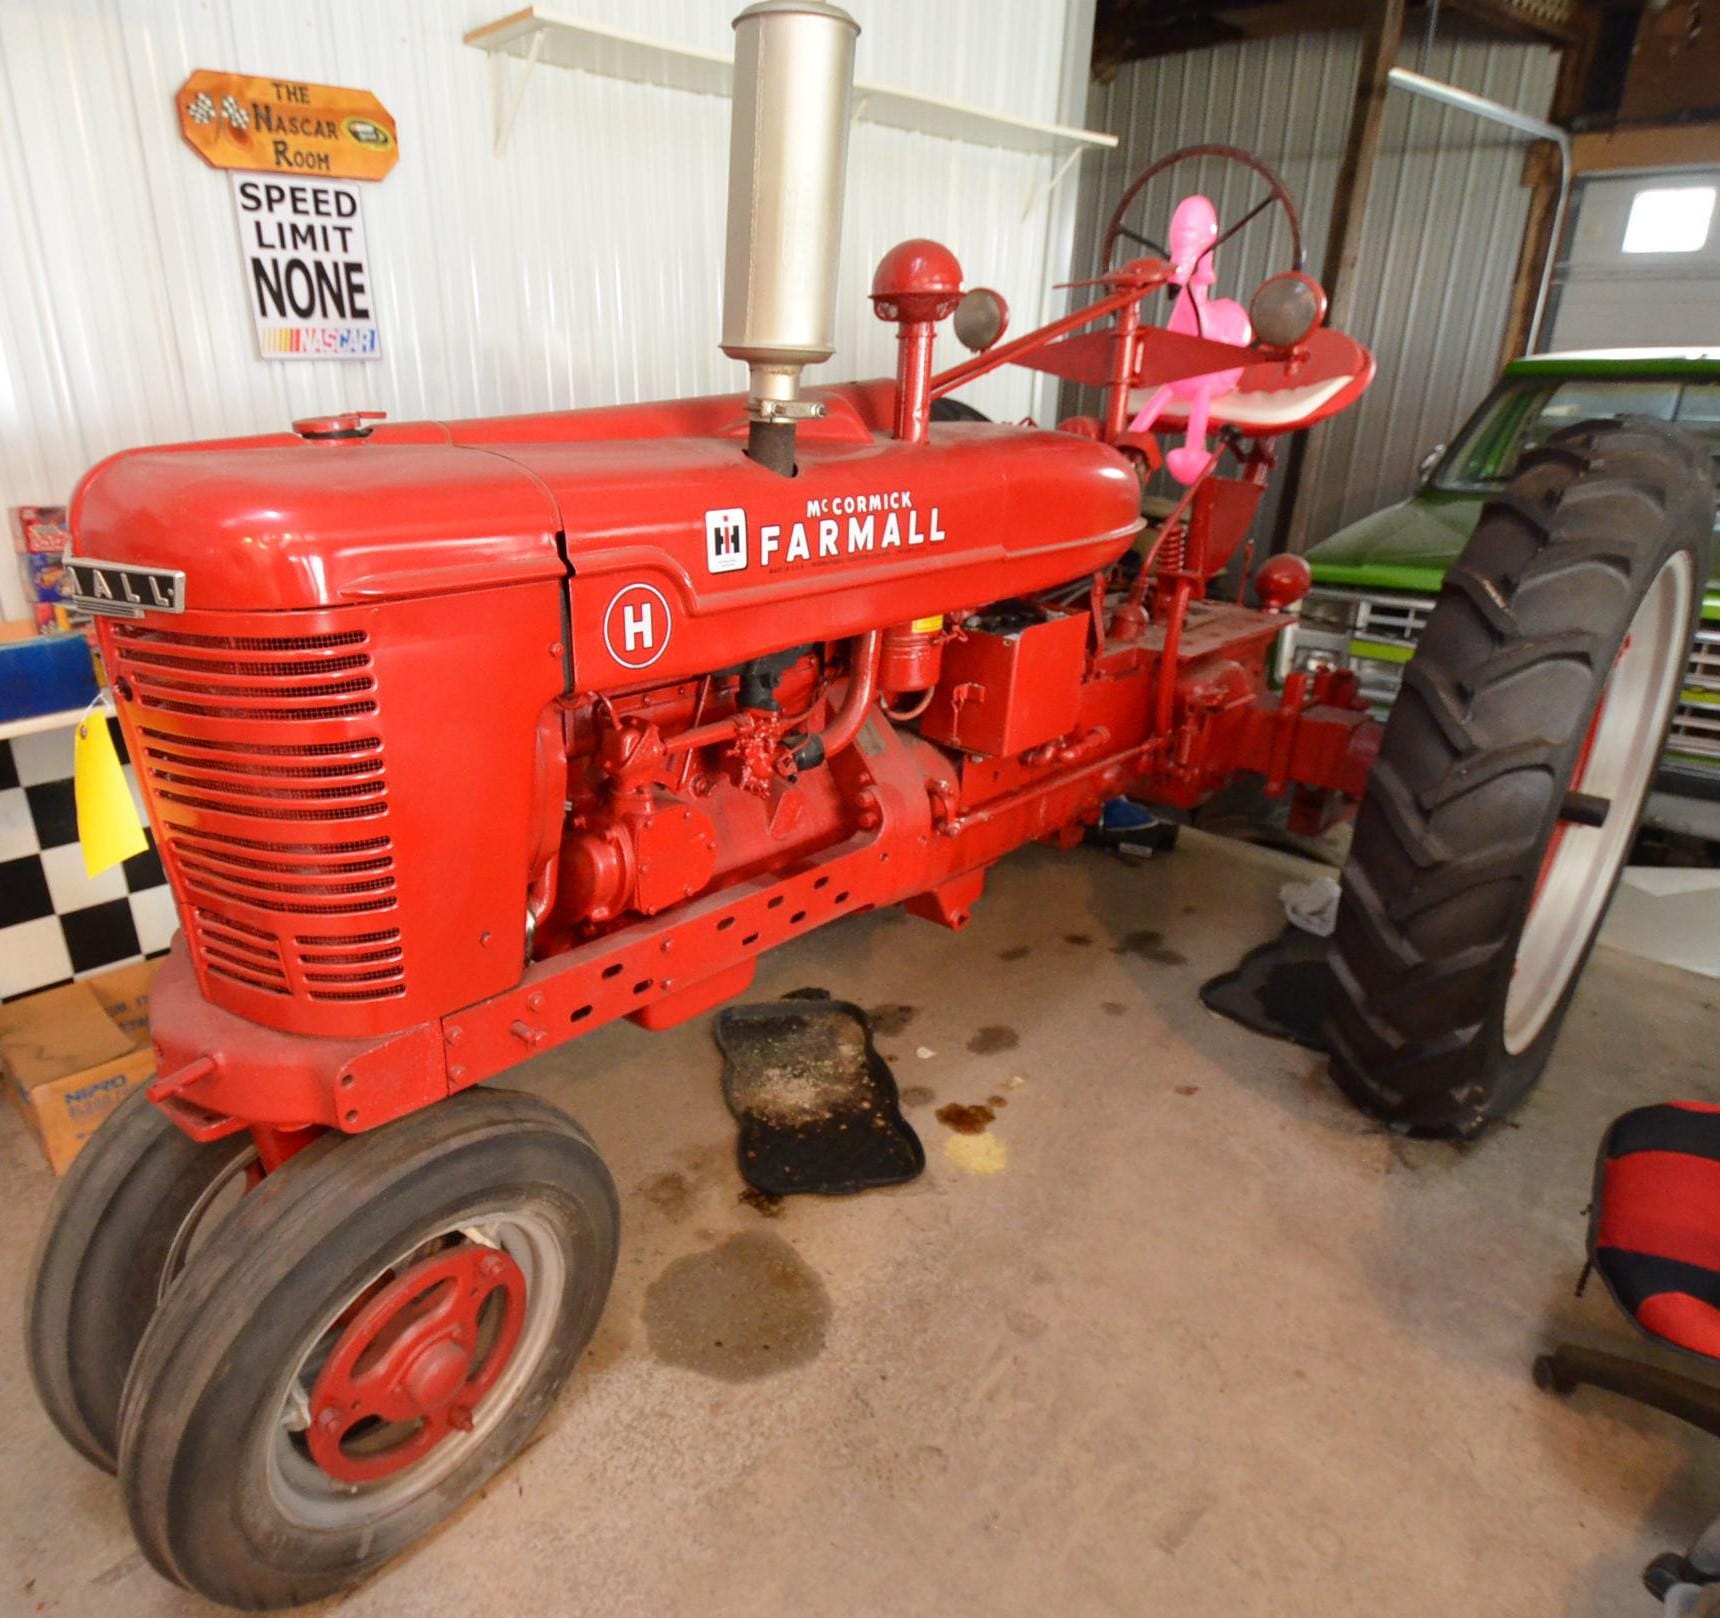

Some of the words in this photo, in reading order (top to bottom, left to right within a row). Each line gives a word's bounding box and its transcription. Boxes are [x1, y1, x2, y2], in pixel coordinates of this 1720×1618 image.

[271, 83, 311, 105] THE
[252, 103, 339, 139] NASCAR
[272, 140, 331, 171] ROOM
[239, 182, 358, 218] SPEED
[254, 220, 353, 253] LIMIT
[251, 256, 370, 320] NONE
[759, 506, 947, 567] FARMALL
[623, 602, 653, 651] H
